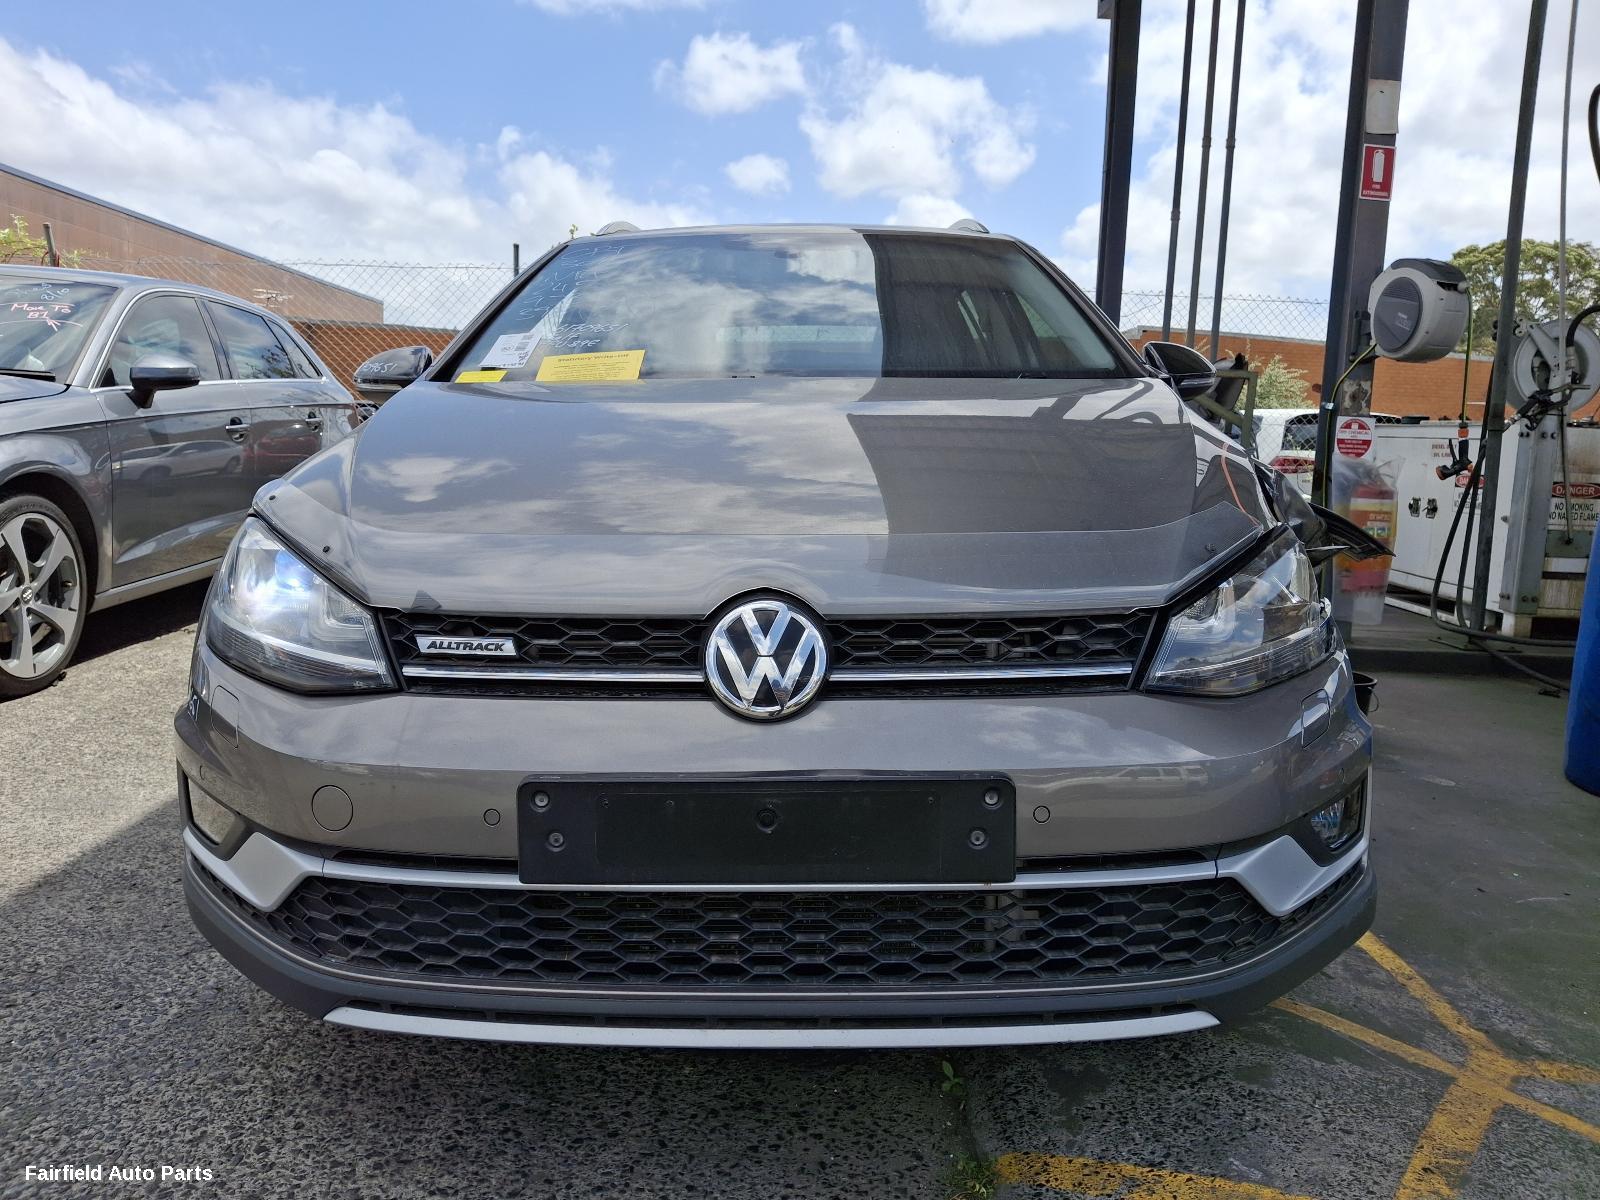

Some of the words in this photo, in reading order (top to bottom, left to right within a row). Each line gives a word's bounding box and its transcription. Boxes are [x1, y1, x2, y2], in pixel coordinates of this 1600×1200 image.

[1567, 503, 1594, 512] MOKING
[1558, 512, 1579, 520] NAED
[427, 641, 505, 652] ALLTRACK
